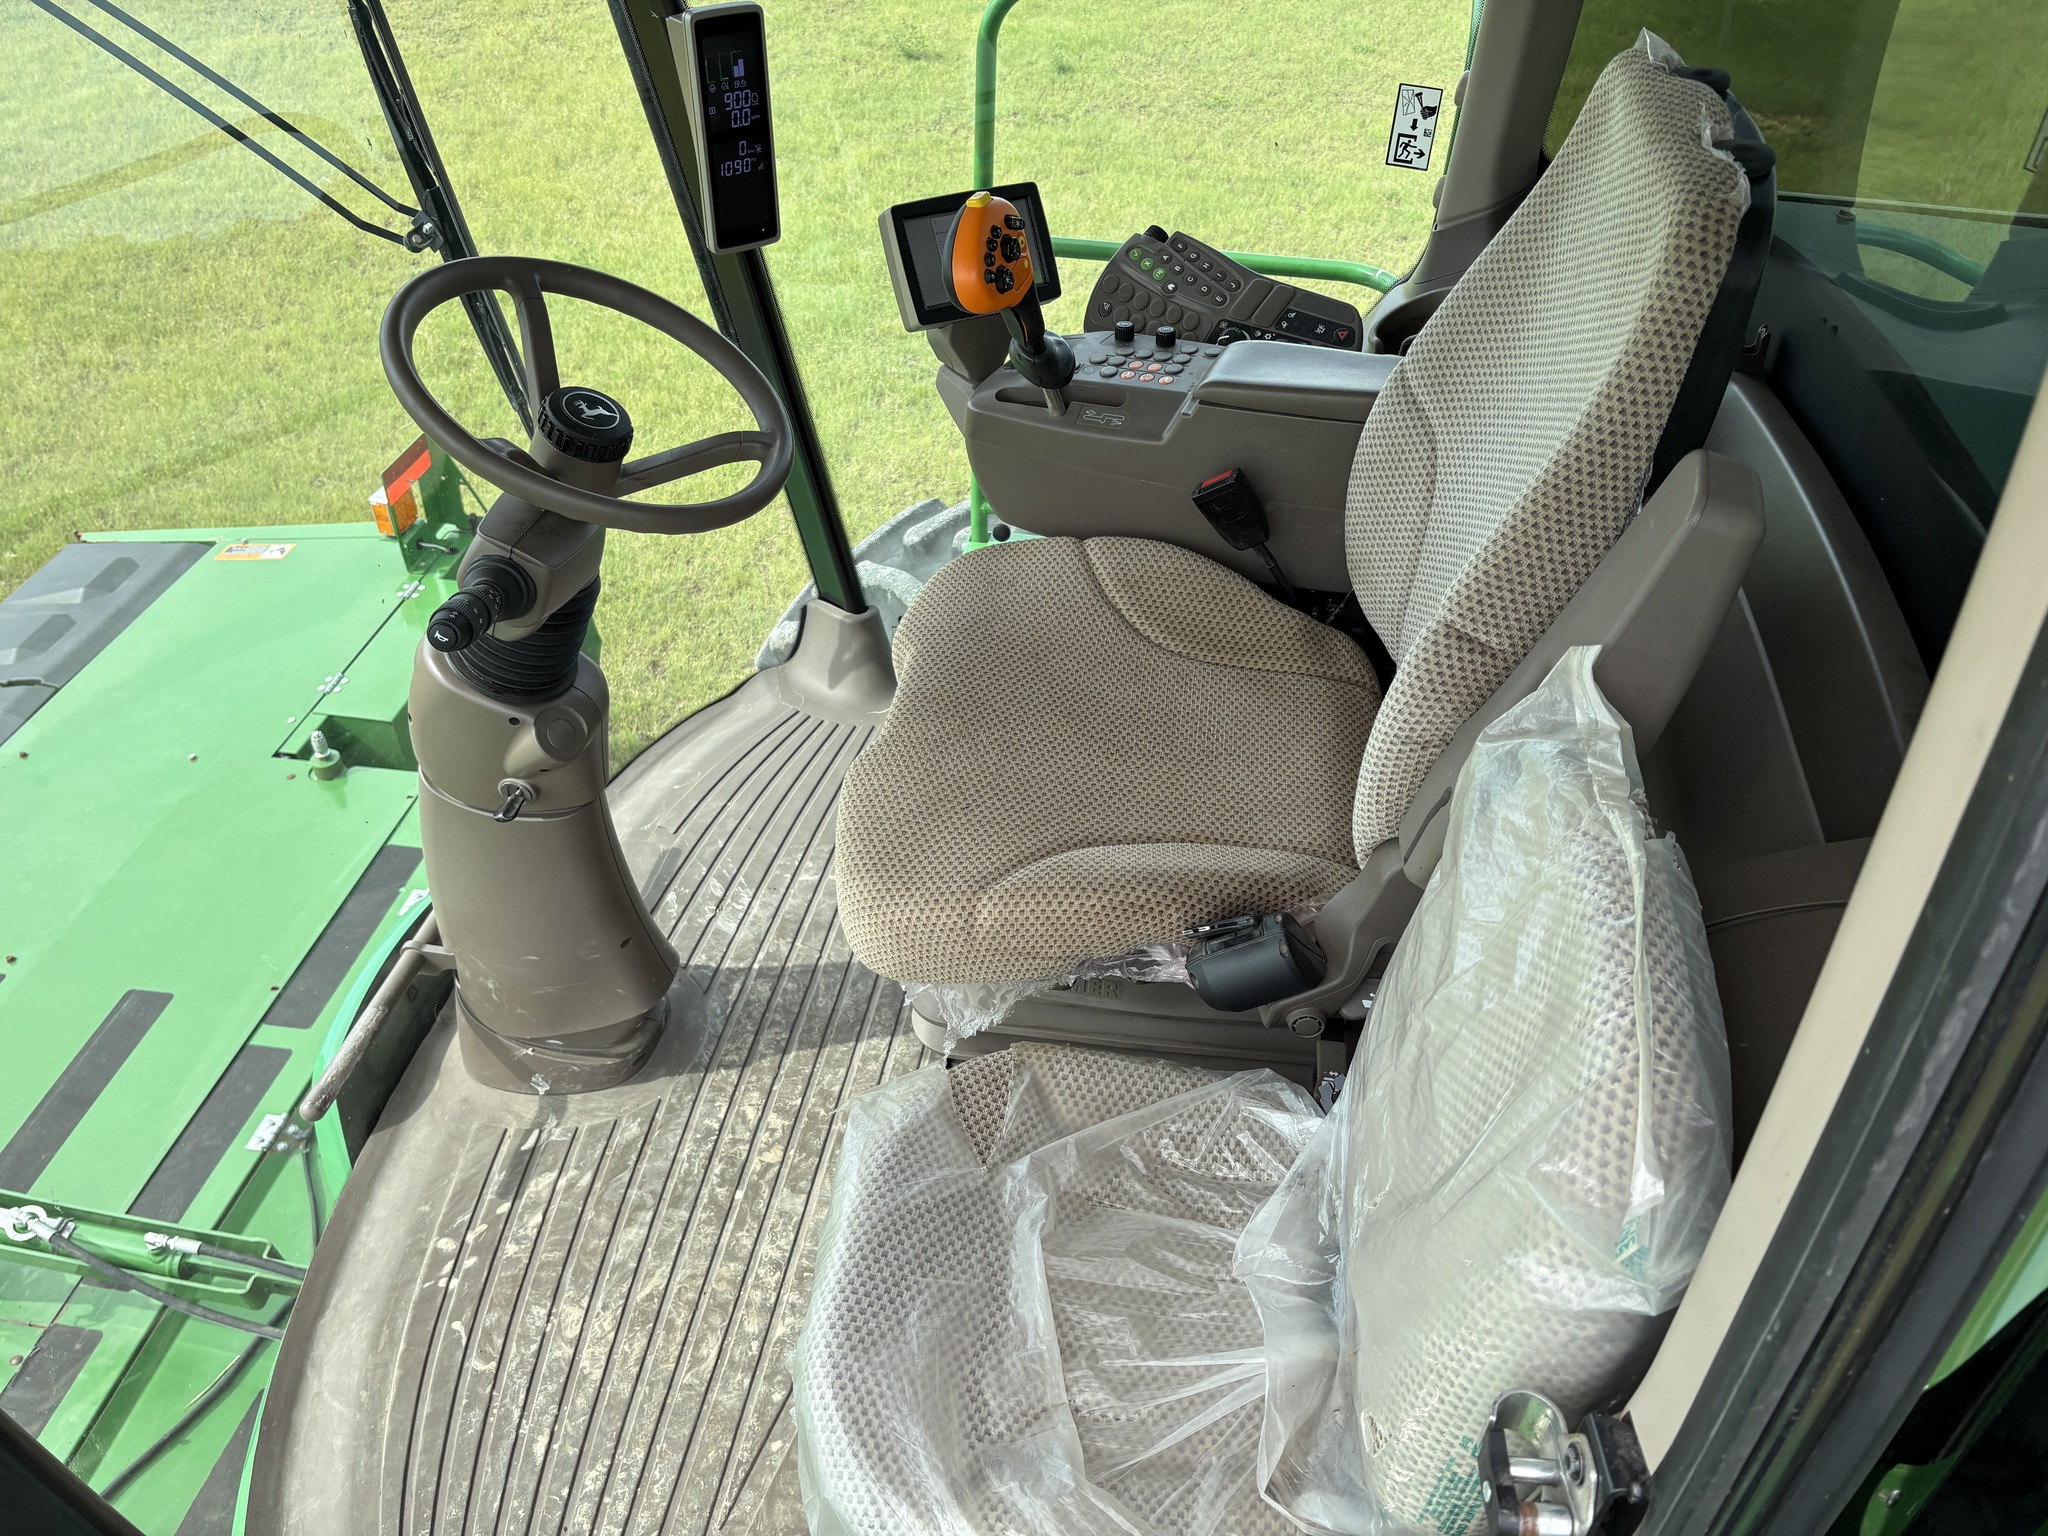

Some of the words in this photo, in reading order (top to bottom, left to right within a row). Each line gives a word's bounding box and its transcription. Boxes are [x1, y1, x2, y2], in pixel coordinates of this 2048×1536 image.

[724, 89, 751, 110] 900
[731, 108, 751, 128] 0.0
[739, 140, 747, 156] 0
[720, 157, 751, 177] 1090
